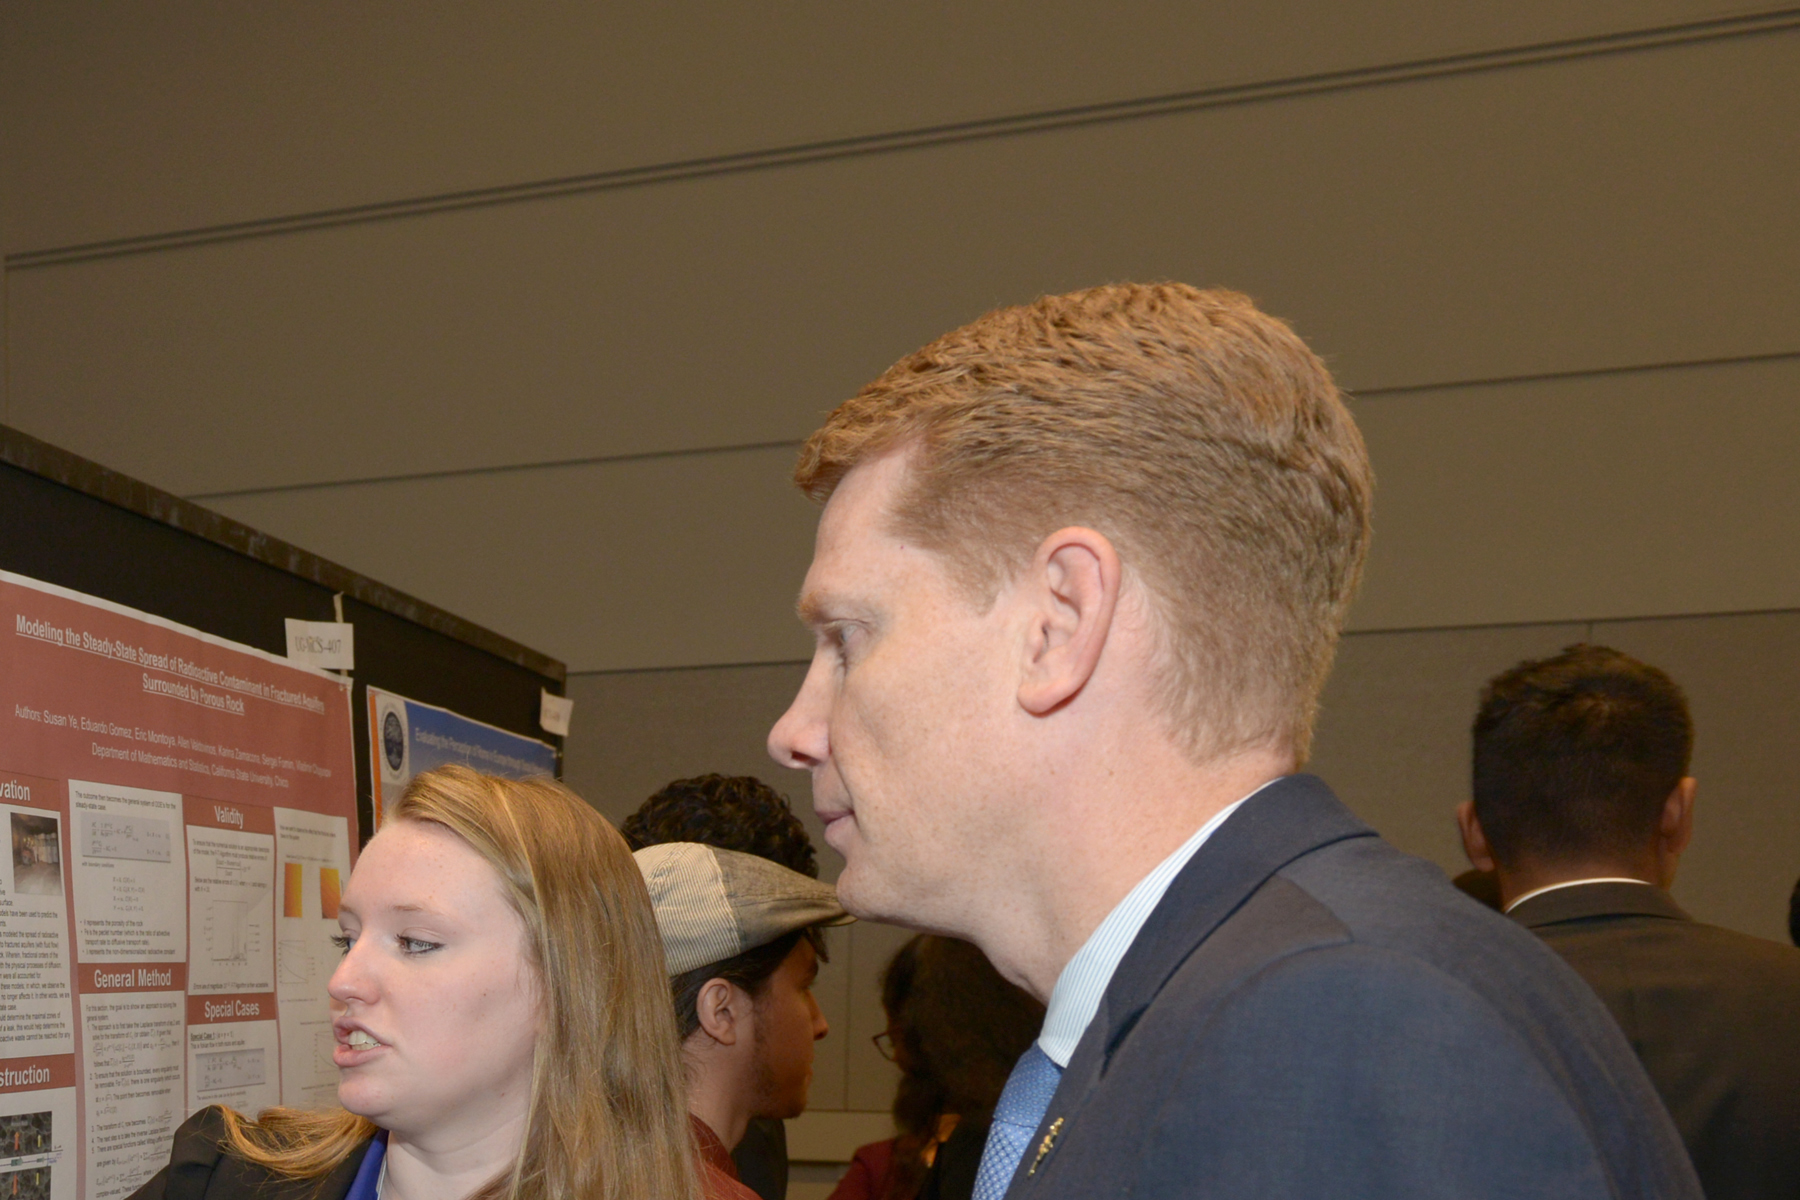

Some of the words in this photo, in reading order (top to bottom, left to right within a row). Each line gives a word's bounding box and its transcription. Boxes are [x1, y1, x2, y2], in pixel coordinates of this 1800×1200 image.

[16, 613, 63, 647] Modeling
[65, 626, 81, 647] the
[83, 631, 137, 664] Steady-State
[138, 647, 168, 672] Spread
[169, 653, 178, 672] of
[178, 658, 218, 685] Radioactive
[219, 667, 262, 696] Contaminant
[142, 673, 189, 701] Surrounded
[190, 684, 199, 706] by
[200, 689, 223, 711] Porous
[225, 694, 245, 714] Rock
[213, 805, 244, 830] Validity
[94, 969, 135, 988] General
[138, 968, 171, 987] Method
[204, 1000, 234, 1022] Special
[235, 999, 260, 1016] Cases
